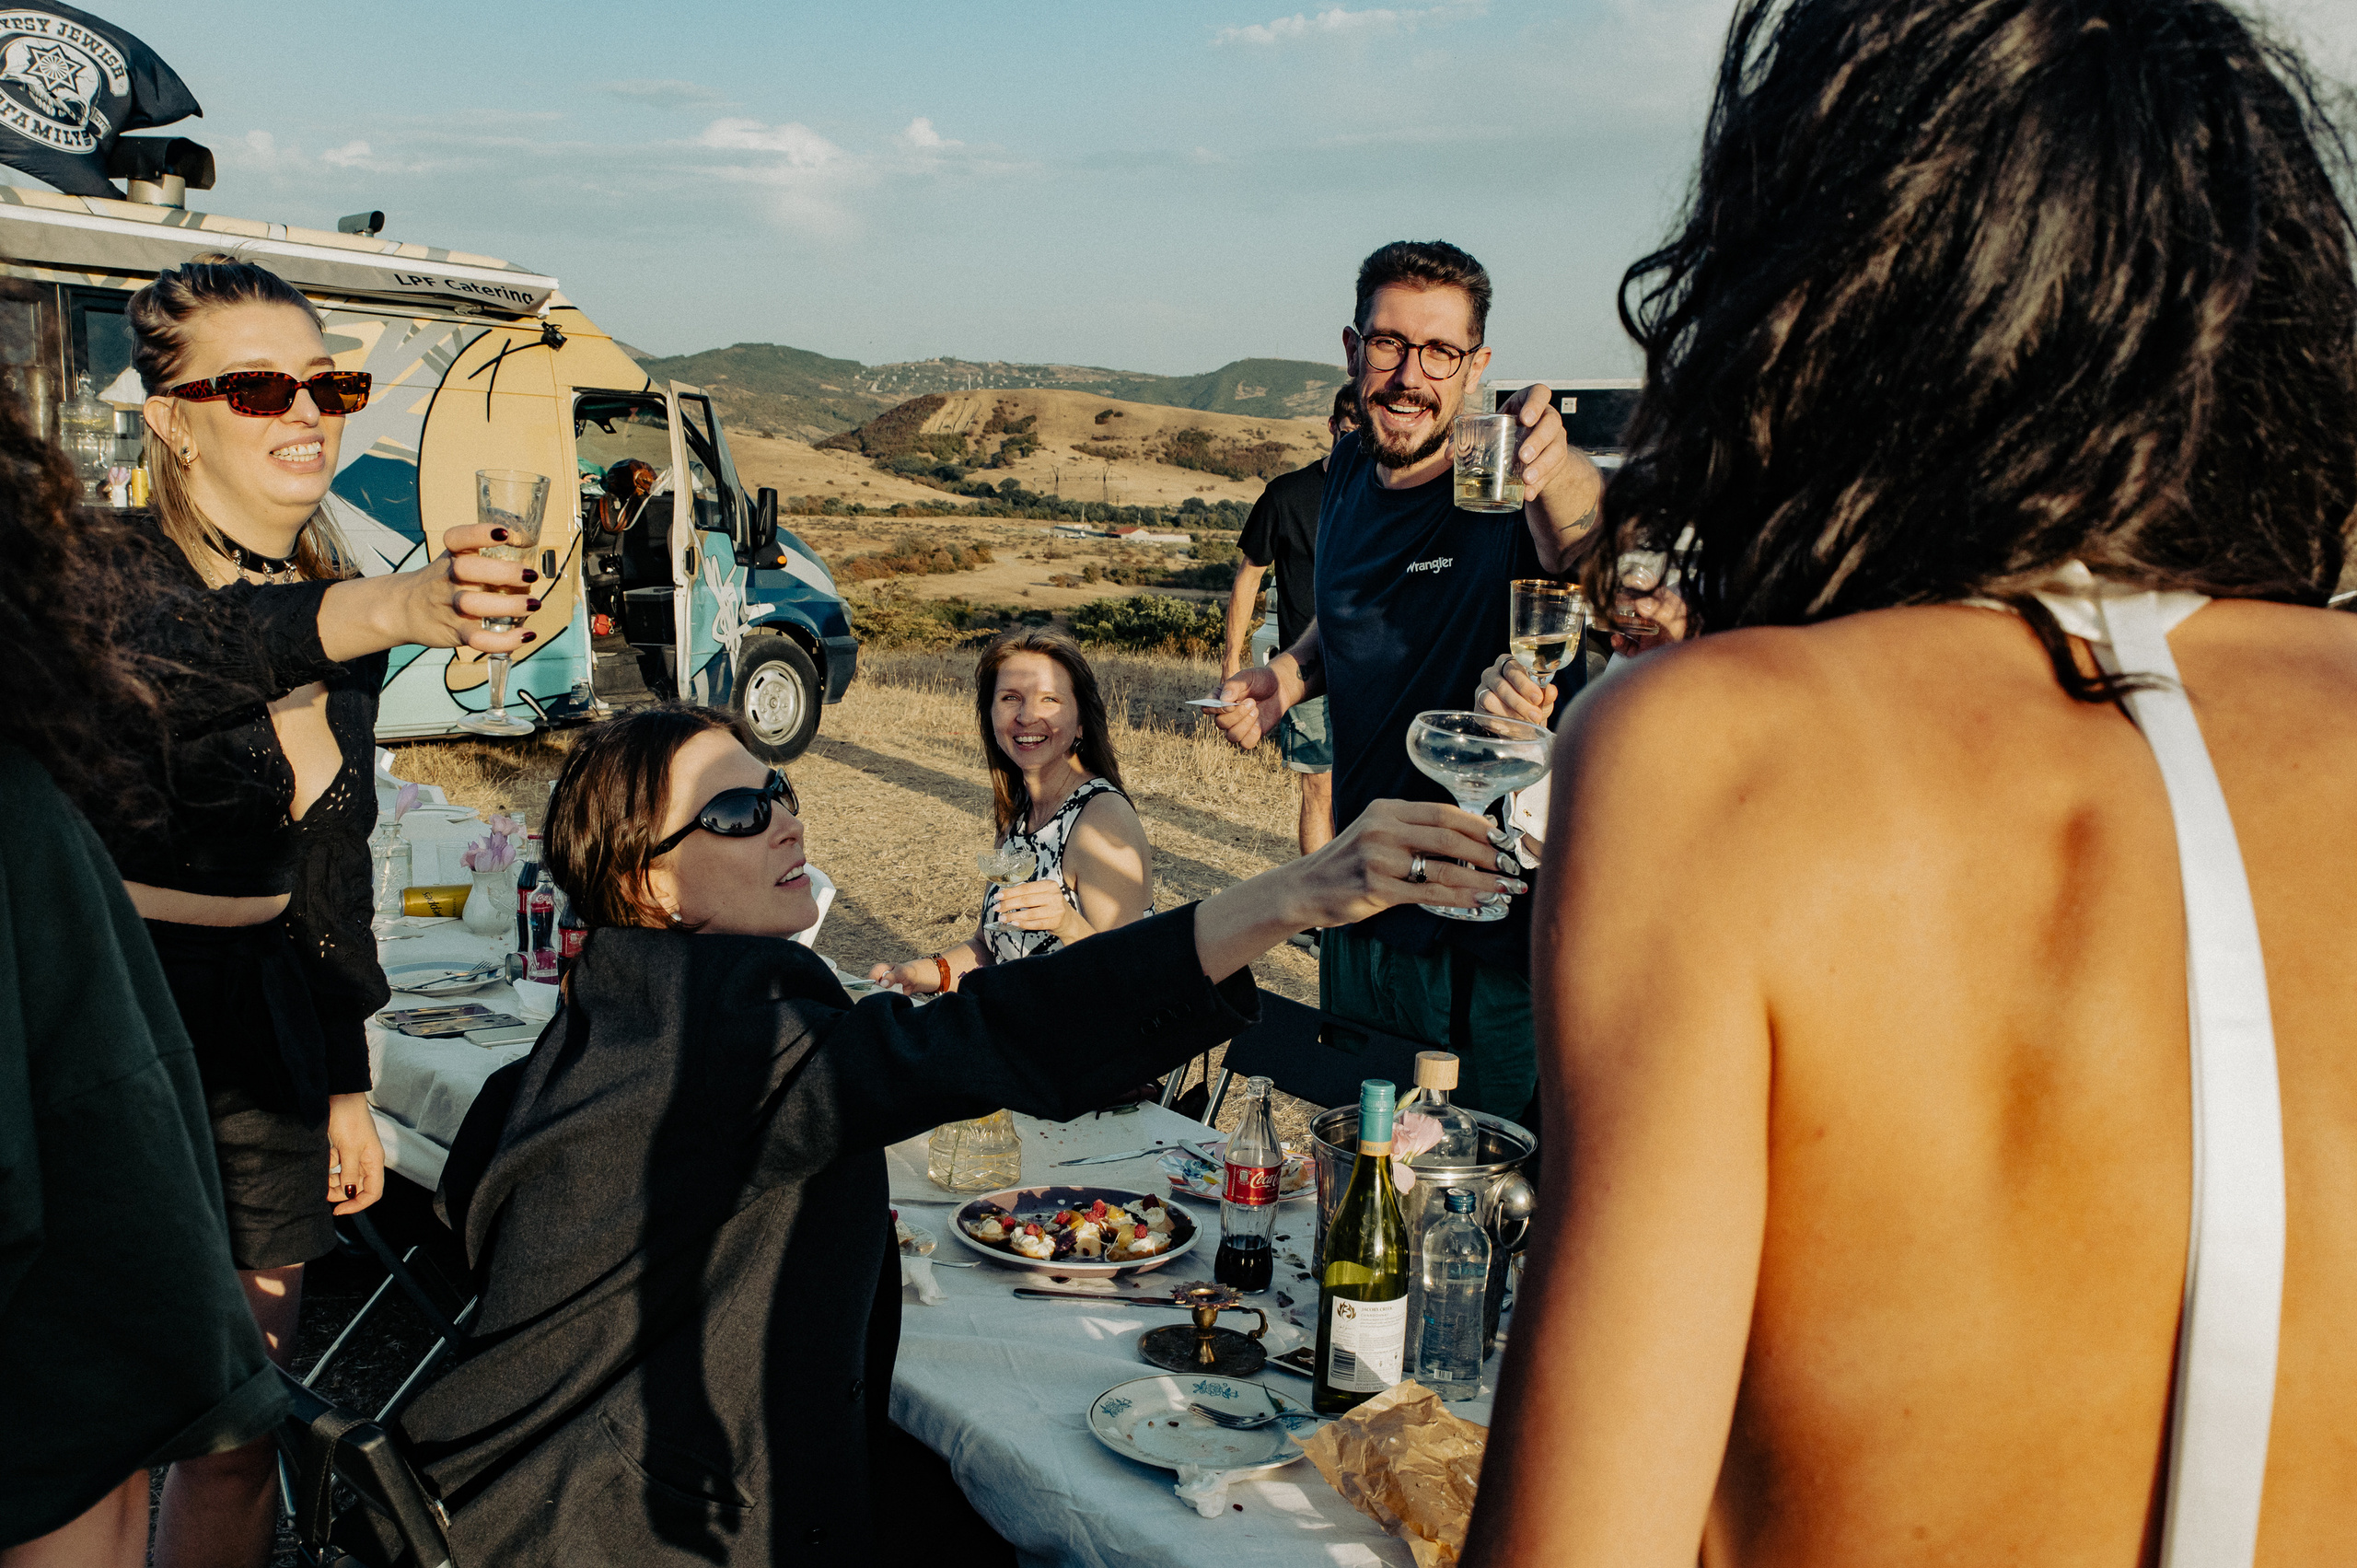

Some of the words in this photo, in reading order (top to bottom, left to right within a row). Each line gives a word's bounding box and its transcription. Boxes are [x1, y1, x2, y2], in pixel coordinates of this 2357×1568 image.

[0, 17, 51, 33] YPSY
[57, 22, 125, 80] JEWISH
[0, 101, 81, 145] FAMILY
[394, 273, 435, 286] LPF
